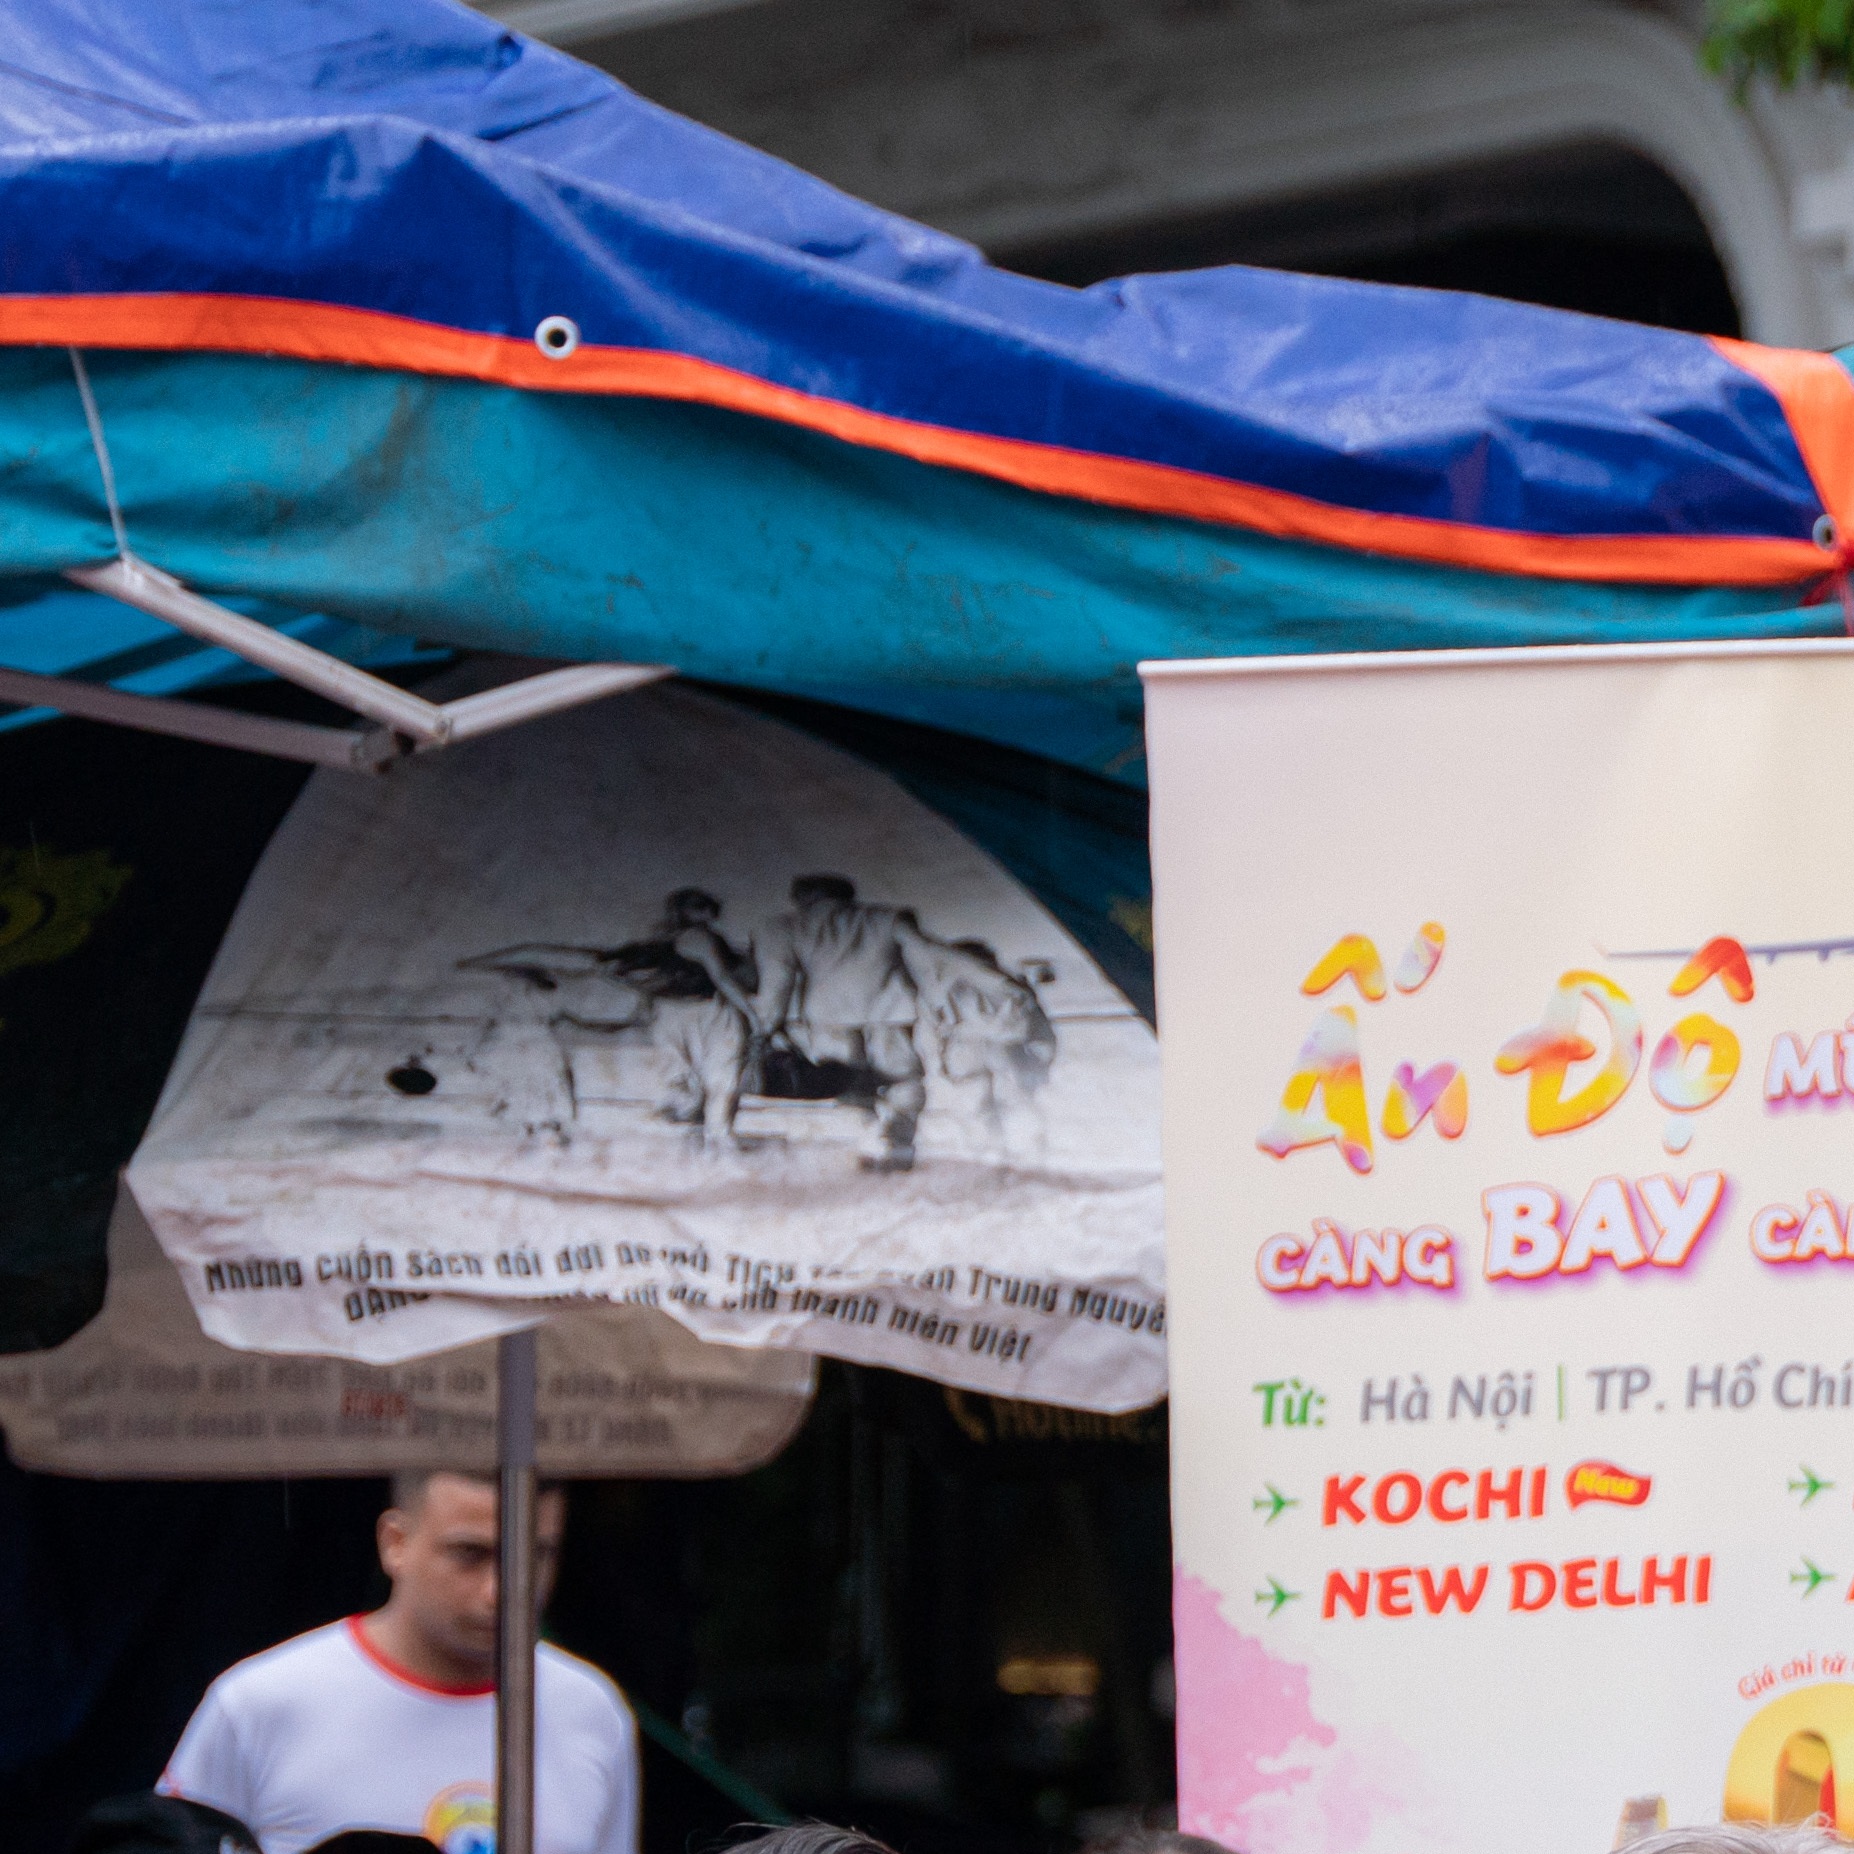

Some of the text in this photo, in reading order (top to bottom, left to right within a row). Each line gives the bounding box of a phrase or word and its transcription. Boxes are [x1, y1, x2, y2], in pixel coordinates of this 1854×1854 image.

[1255, 920, 1469, 1175] Ấn
[1494, 935, 1755, 1155] Độ
[1256, 1218, 1455, 1292] CÀNG
[1480, 1170, 1727, 1281] BAY
[1360, 1374, 1430, 1423] Hà
[1448, 1370, 1536, 1430] Nội
[1773, 1360, 1854, 1409] Chí
[1321, 1464, 1549, 1527] KOCHI
[1321, 1553, 1714, 1620] NEW DELHI
